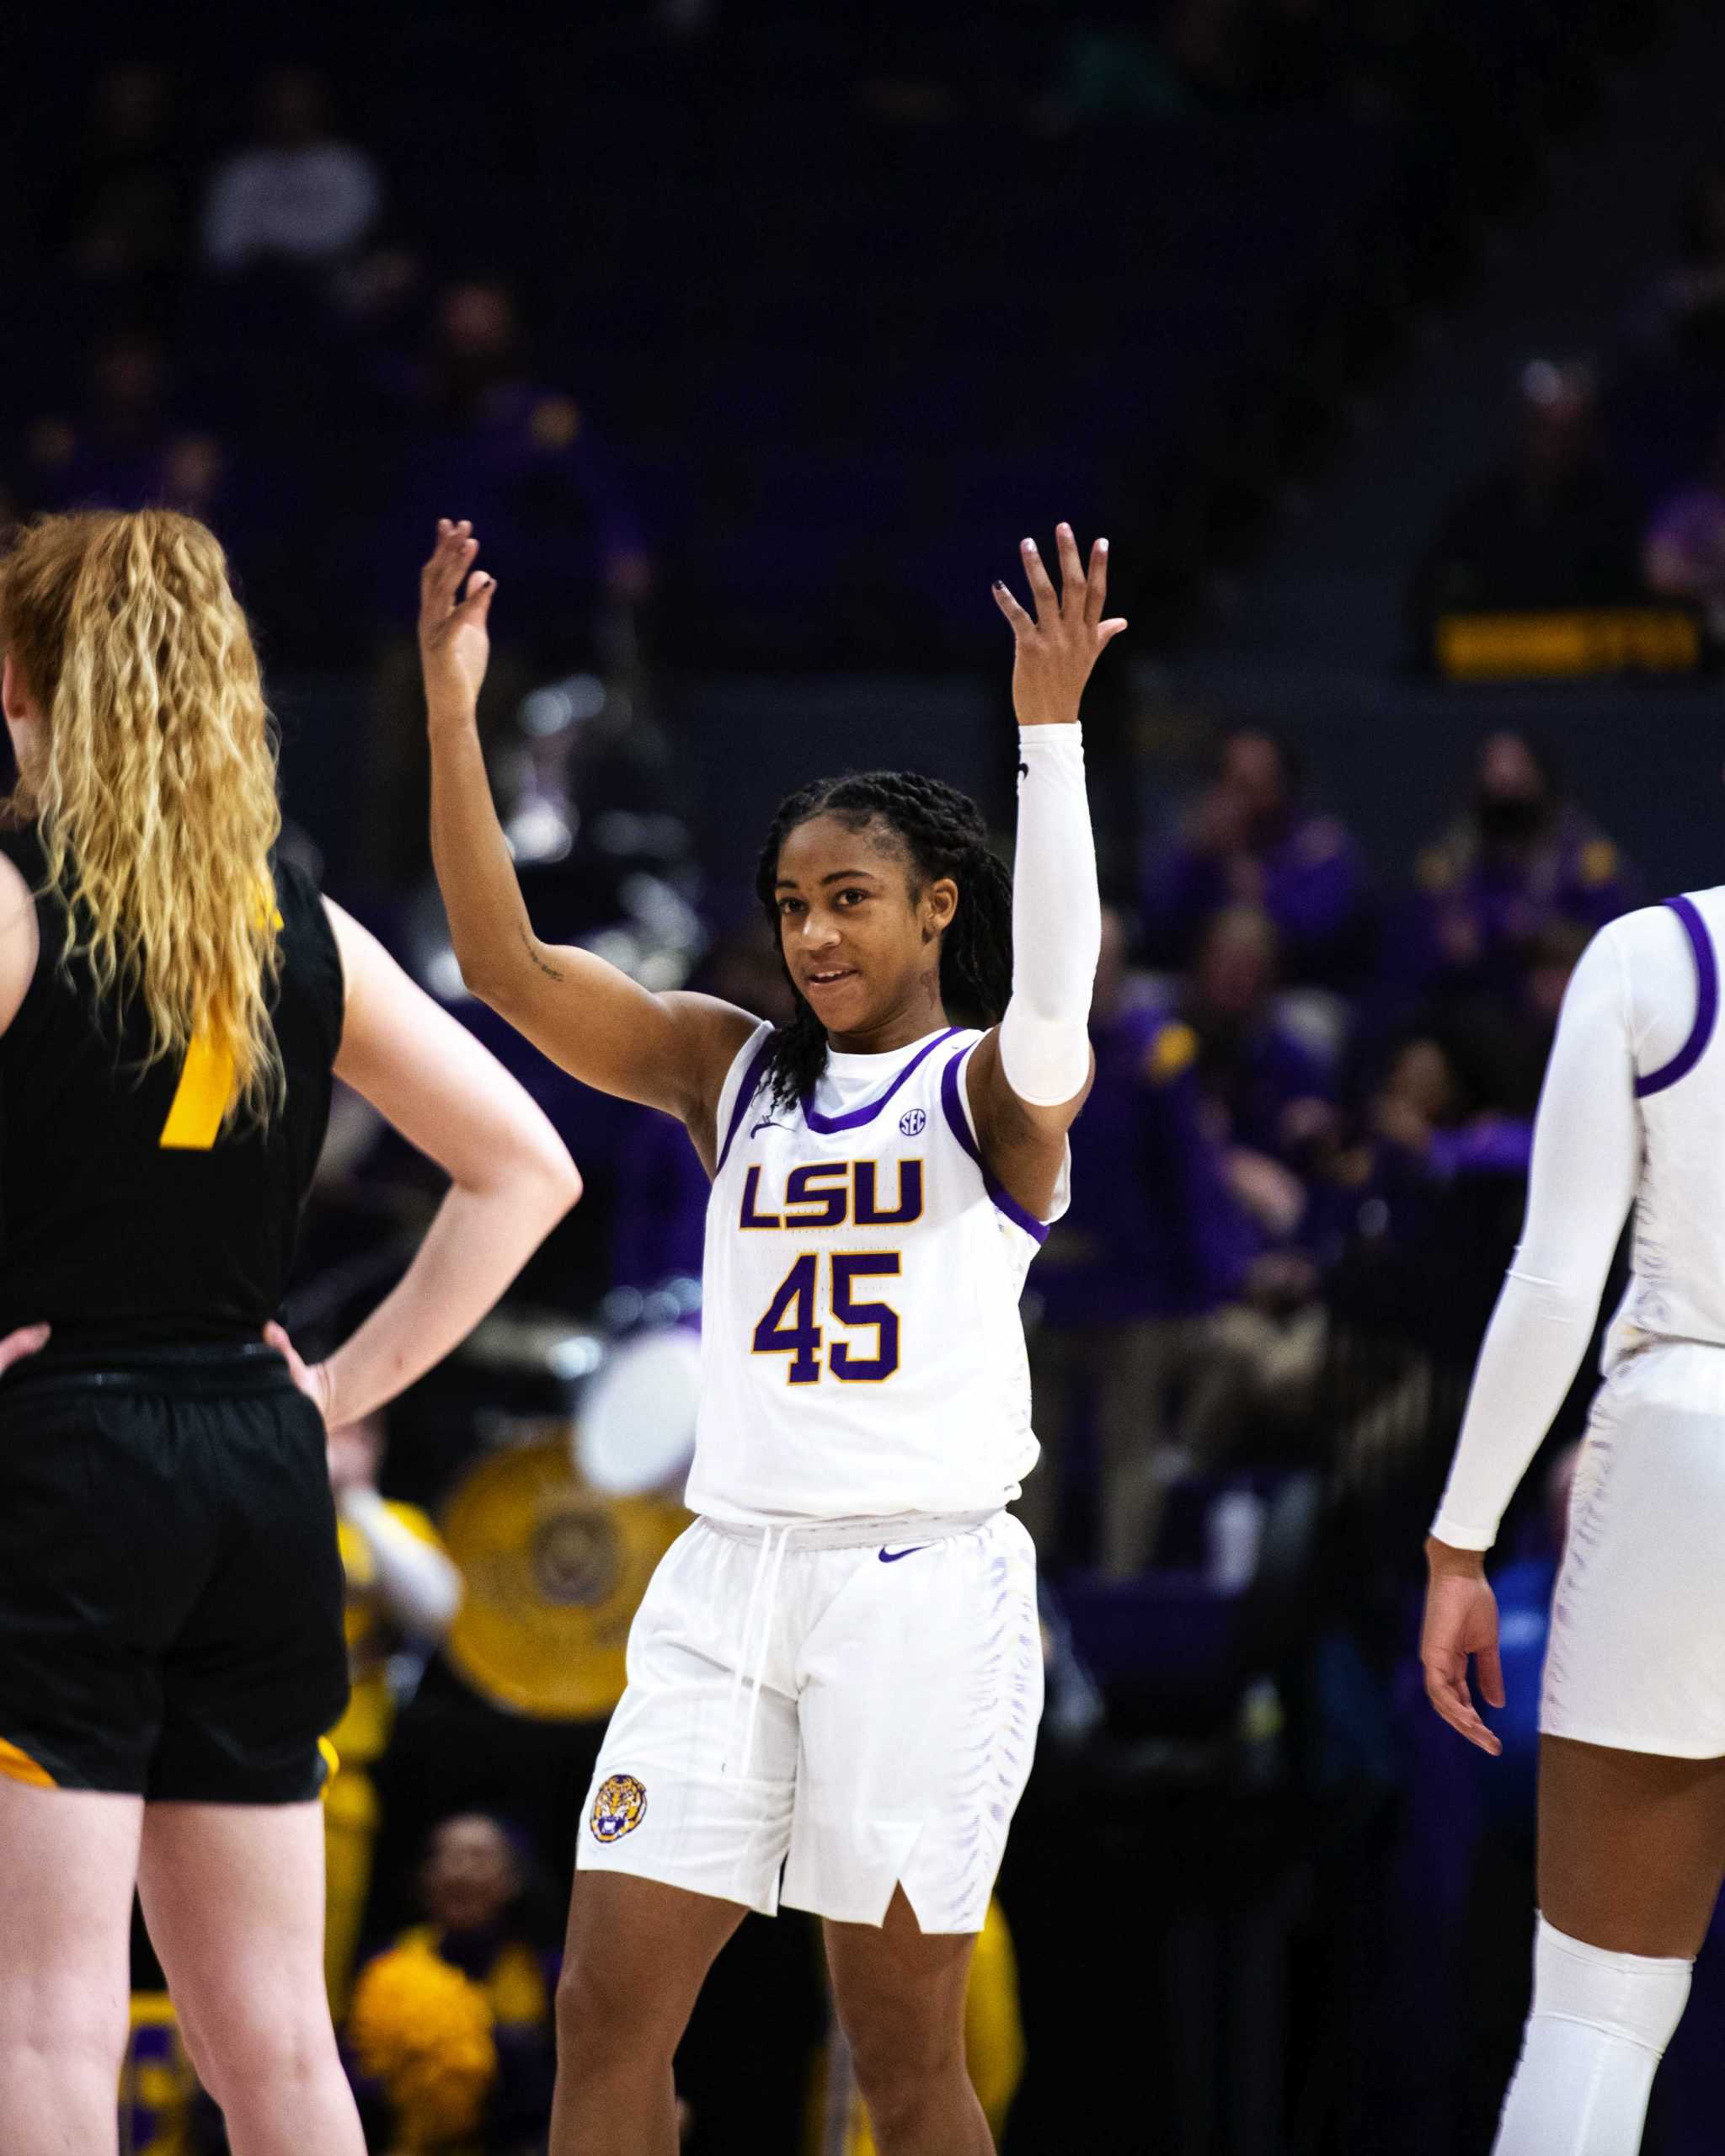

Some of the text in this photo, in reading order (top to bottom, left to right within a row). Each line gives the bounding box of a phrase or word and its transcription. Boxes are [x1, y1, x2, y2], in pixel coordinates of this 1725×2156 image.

[900, 1108, 926, 1136] SEC
[740, 1159, 923, 1230] LSU
[751, 1251, 902, 1385] 45
